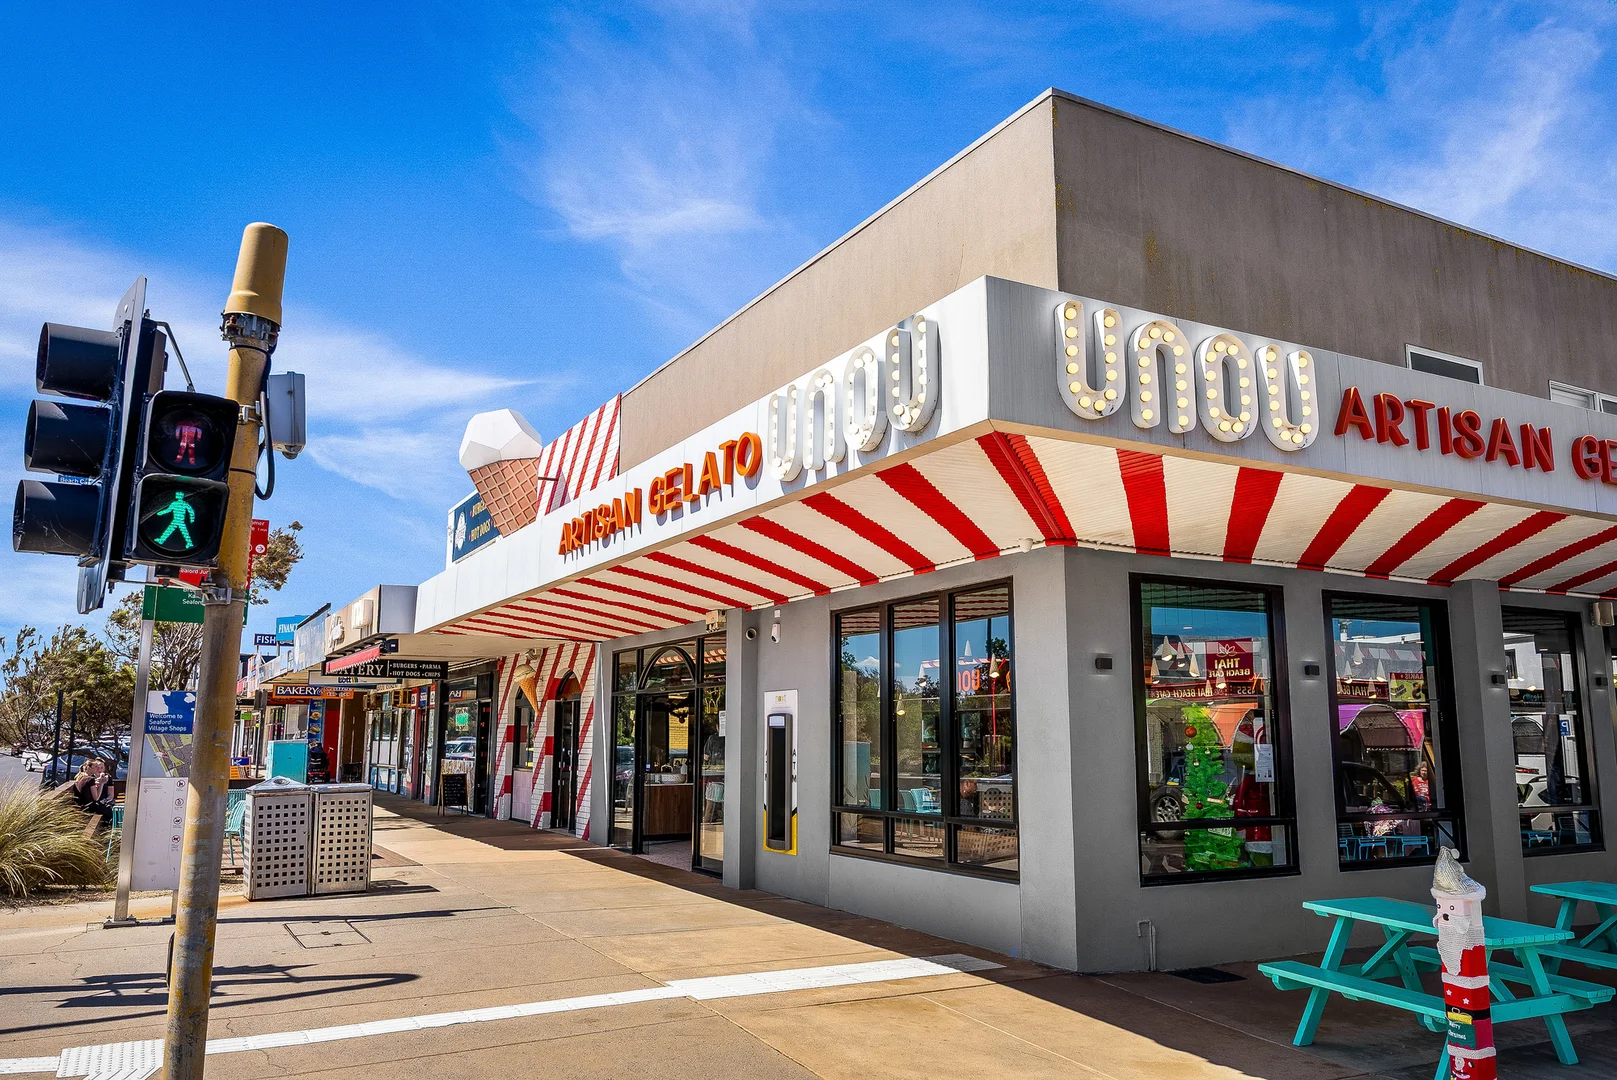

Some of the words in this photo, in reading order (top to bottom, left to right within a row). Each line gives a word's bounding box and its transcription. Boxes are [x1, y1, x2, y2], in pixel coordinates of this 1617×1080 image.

[1335, 386, 1555, 472] ARTISAN
[558, 487, 642, 556] ARTISAN
[648, 431, 763, 516] GELATO
[256, 635, 276, 644] FISH
[392, 662, 418, 670] BURGERS
[277, 686, 318, 695] BAKERY
